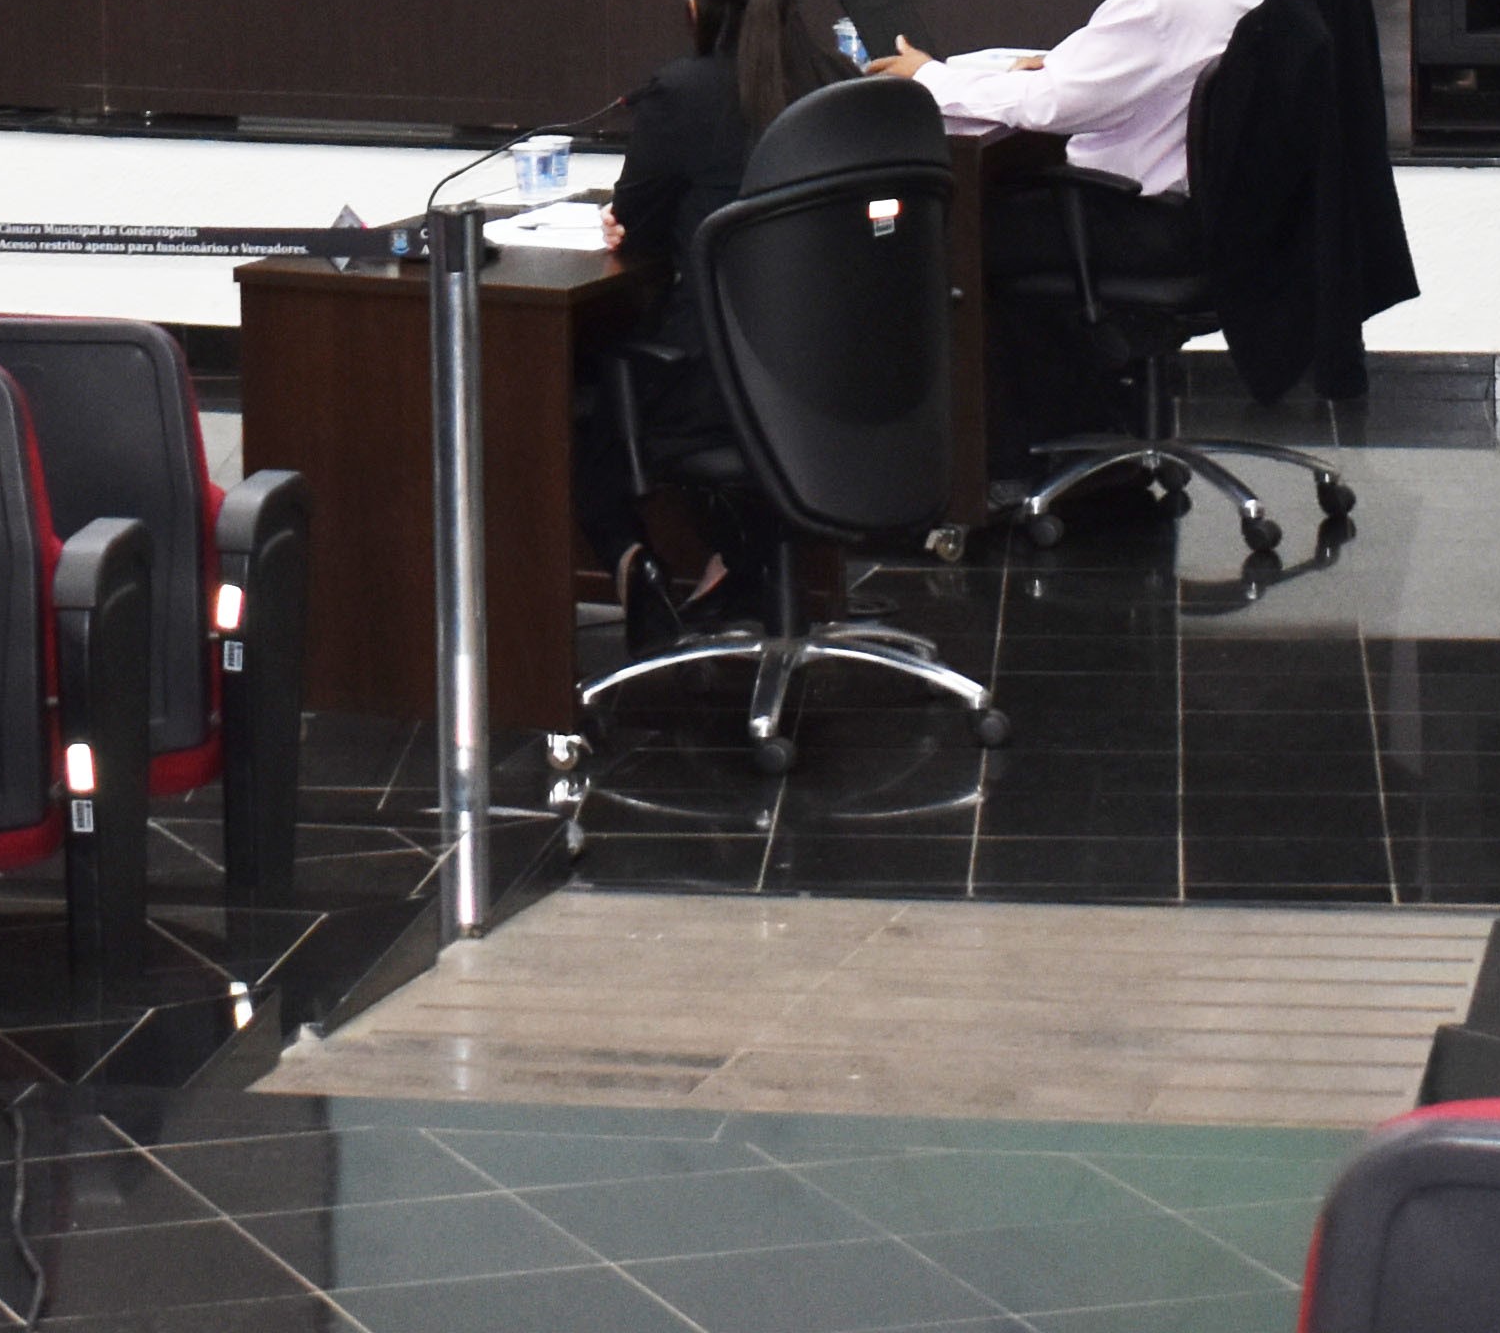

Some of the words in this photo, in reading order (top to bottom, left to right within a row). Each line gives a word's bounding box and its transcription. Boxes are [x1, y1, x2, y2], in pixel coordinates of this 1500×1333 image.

[44, 222, 100, 237] Municipal
[103, 224, 116, 235] de
[39, 239, 82, 251] restrito
[85, 241, 125, 254] apenas
[128, 243, 154, 255] para
[156, 240, 229, 254] funcionários
